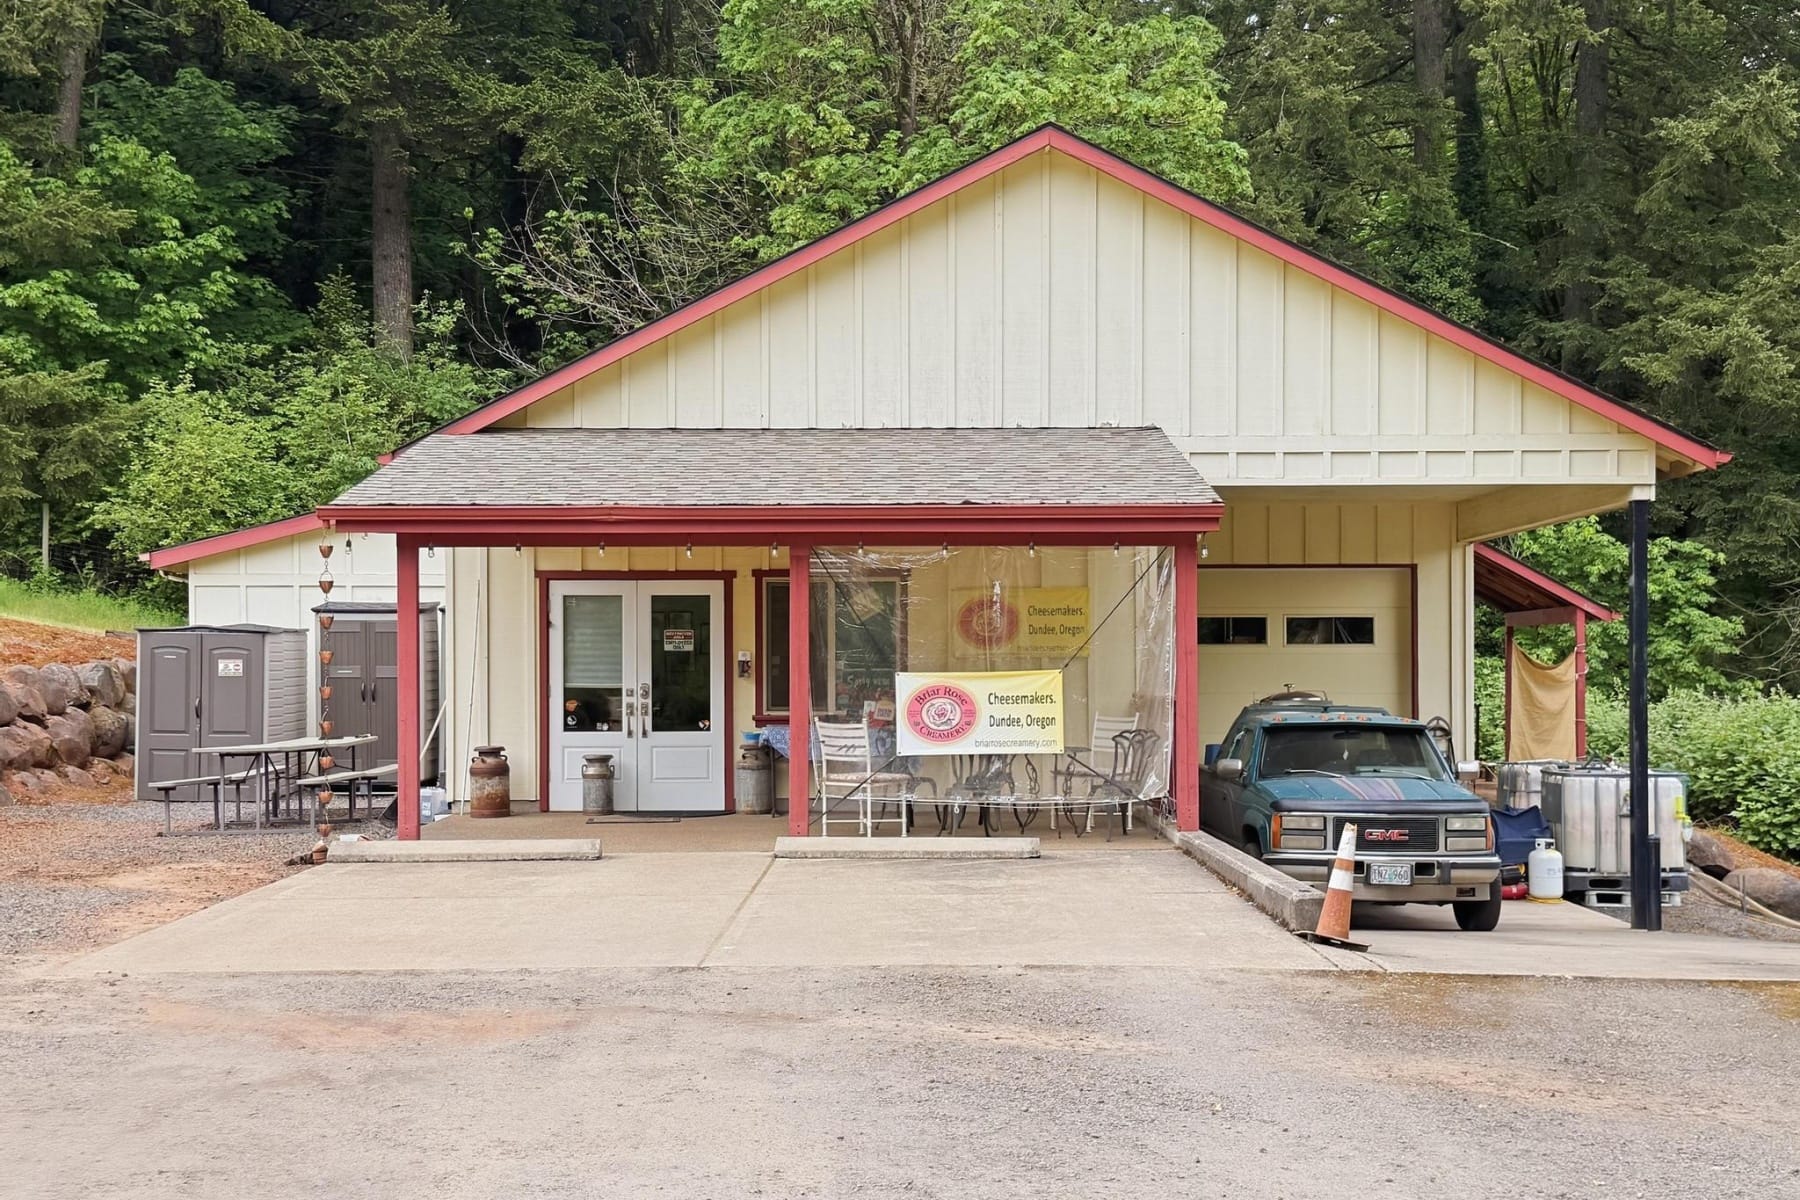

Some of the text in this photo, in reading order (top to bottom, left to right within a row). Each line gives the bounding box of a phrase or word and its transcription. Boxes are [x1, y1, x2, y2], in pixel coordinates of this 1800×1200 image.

[1027, 605, 1085, 617] Cheesemakers.
[1028, 624, 1085, 637] Dundee, Oregon
[915, 686, 968, 706] Briar Rose
[988, 691, 1057, 705] Cheesemakers.
[989, 714, 1024, 728] Dundee,
[1026, 714, 1056, 729] Oregon
[974, 739, 1058, 748] briarrosecreamery.com
[1365, 829, 1409, 840] GMC
